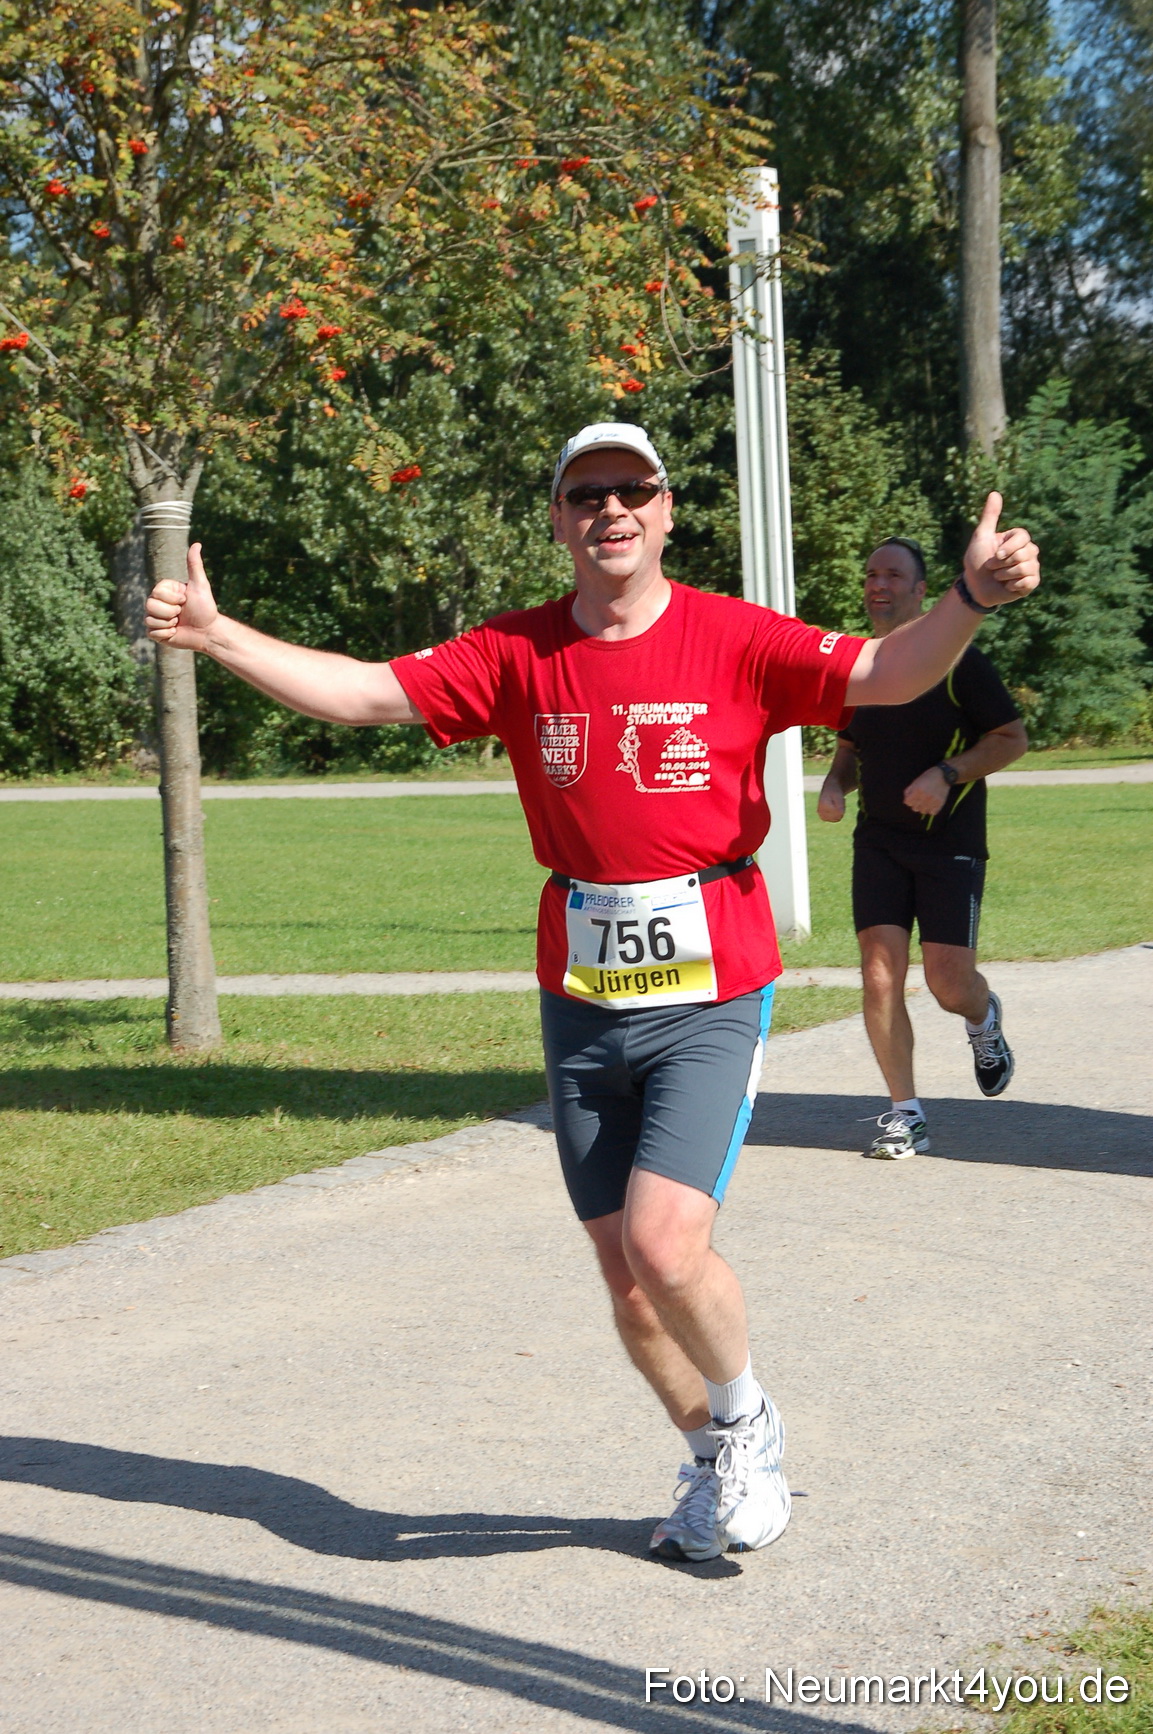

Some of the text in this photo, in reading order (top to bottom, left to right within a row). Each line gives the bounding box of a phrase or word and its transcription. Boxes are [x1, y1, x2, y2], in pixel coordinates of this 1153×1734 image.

[611, 702, 708, 716] 11. NEUMARKTER
[626, 713, 694, 726] STADTLAUF
[541, 724, 578, 736] IMMER
[540, 736, 580, 748] WIEDER
[541, 747, 577, 764] NEU
[544, 764, 578, 776] MARKT
[585, 893, 635, 908] PFLEIDERER
[590, 916, 676, 965] 756
[593, 967, 681, 995] Jürgen
